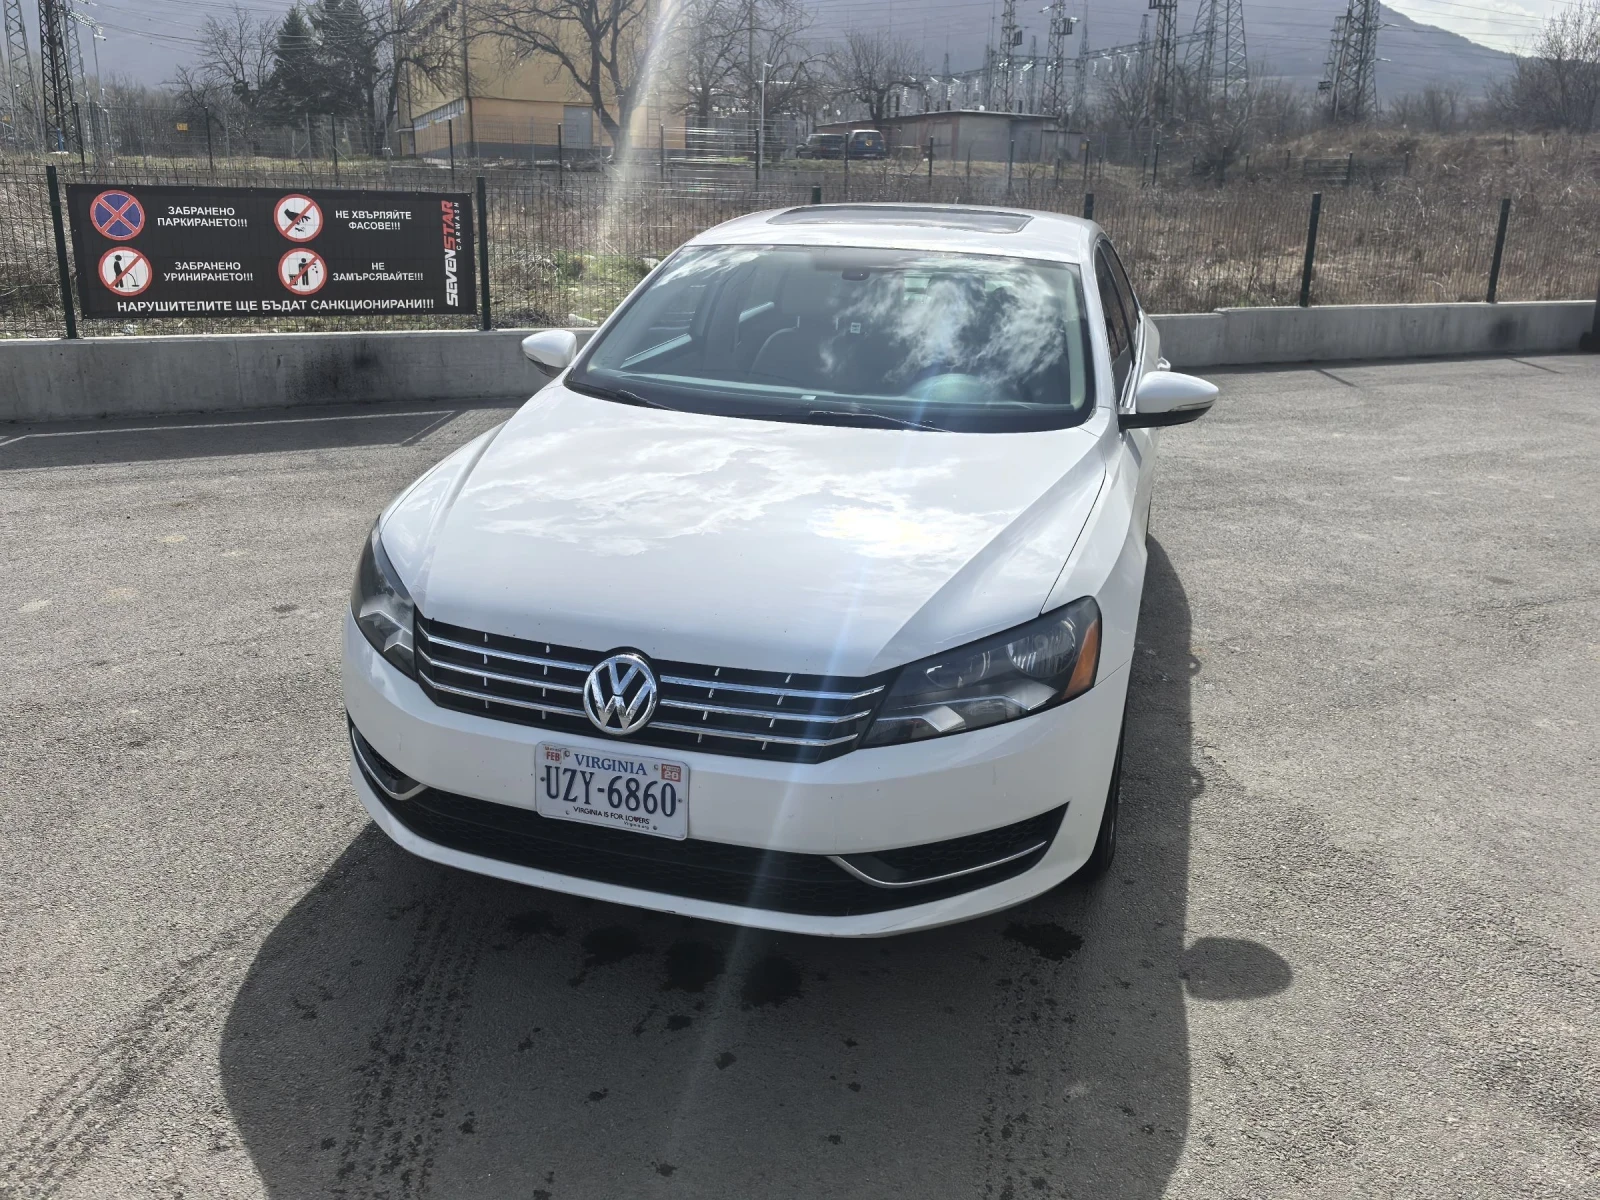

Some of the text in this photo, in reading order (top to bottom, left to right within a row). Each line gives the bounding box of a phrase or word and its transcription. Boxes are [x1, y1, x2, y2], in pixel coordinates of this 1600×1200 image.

[168, 206, 235, 216] ЗАБРАНЕНО
[335, 210, 412, 220] НЕ ХВЪРЛЯЙТЕ
[157, 217, 248, 227] ПАРКИРАНЕТО!!!
[348, 221, 401, 231] ФАСОВЕ!!!
[174, 261, 241, 271] ЗАБРАНЕНО
[371, 262, 385, 271] НЕ
[163, 272, 253, 282] УРИНИРАНЕТО!!!
[332, 271, 424, 281] ЗАМЪРСЯВАЙТЕ!!!
[117, 299, 434, 312] НАРУШИТЕЛИТЕ ЩЕ БЪДАТ САНКЦИОНИРАНИ!!!
[546, 751, 561, 761] FEB
[574, 754, 647, 776] VIRGINIA
[545, 765, 677, 817] UZY-6860
[573, 806, 602, 817] VIRGINIA
[610, 812, 624, 821] FOR
